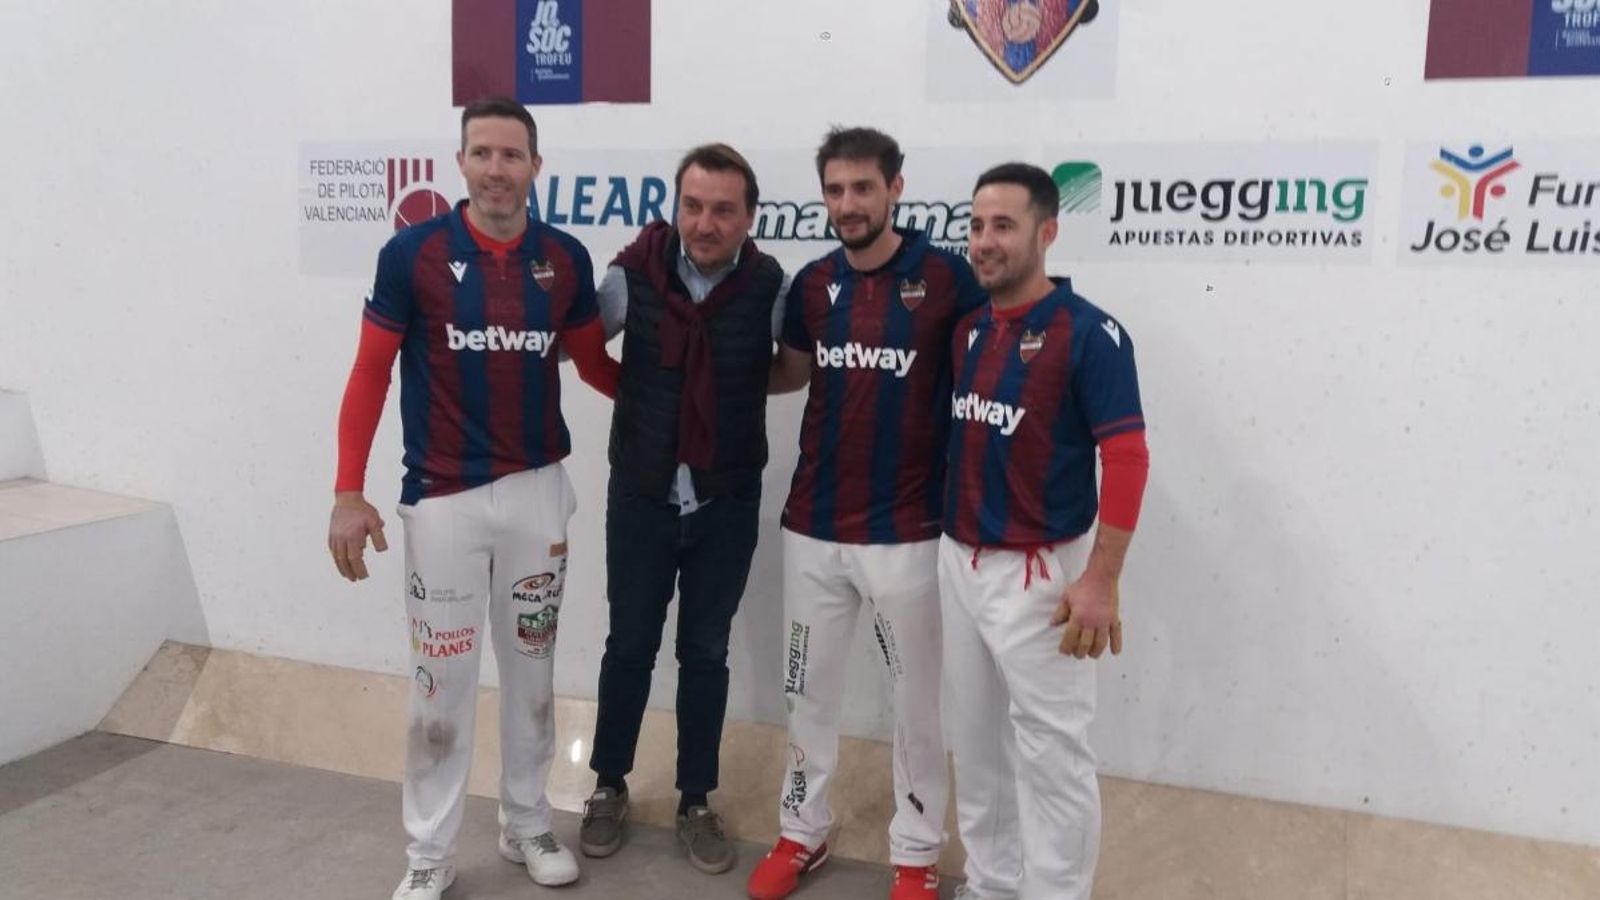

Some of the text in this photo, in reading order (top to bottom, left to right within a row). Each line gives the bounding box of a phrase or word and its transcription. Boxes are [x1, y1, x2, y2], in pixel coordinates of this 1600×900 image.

[535, 53, 572, 66] TROFEU
[310, 158, 386, 176] FEDERACIÓ
[318, 183, 386, 200] DE PILOTA
[1110, 178, 1368, 223] juegging
[305, 206, 386, 223] VALENCIANA
[1109, 230, 1363, 247] APUESTAS DEPORTIVAS
[1410, 218, 1511, 254] José
[446, 323, 556, 359] betway
[817, 340, 917, 378] betway
[435, 627, 476, 641] POLLOS
[423, 639, 473, 658] PLANES
